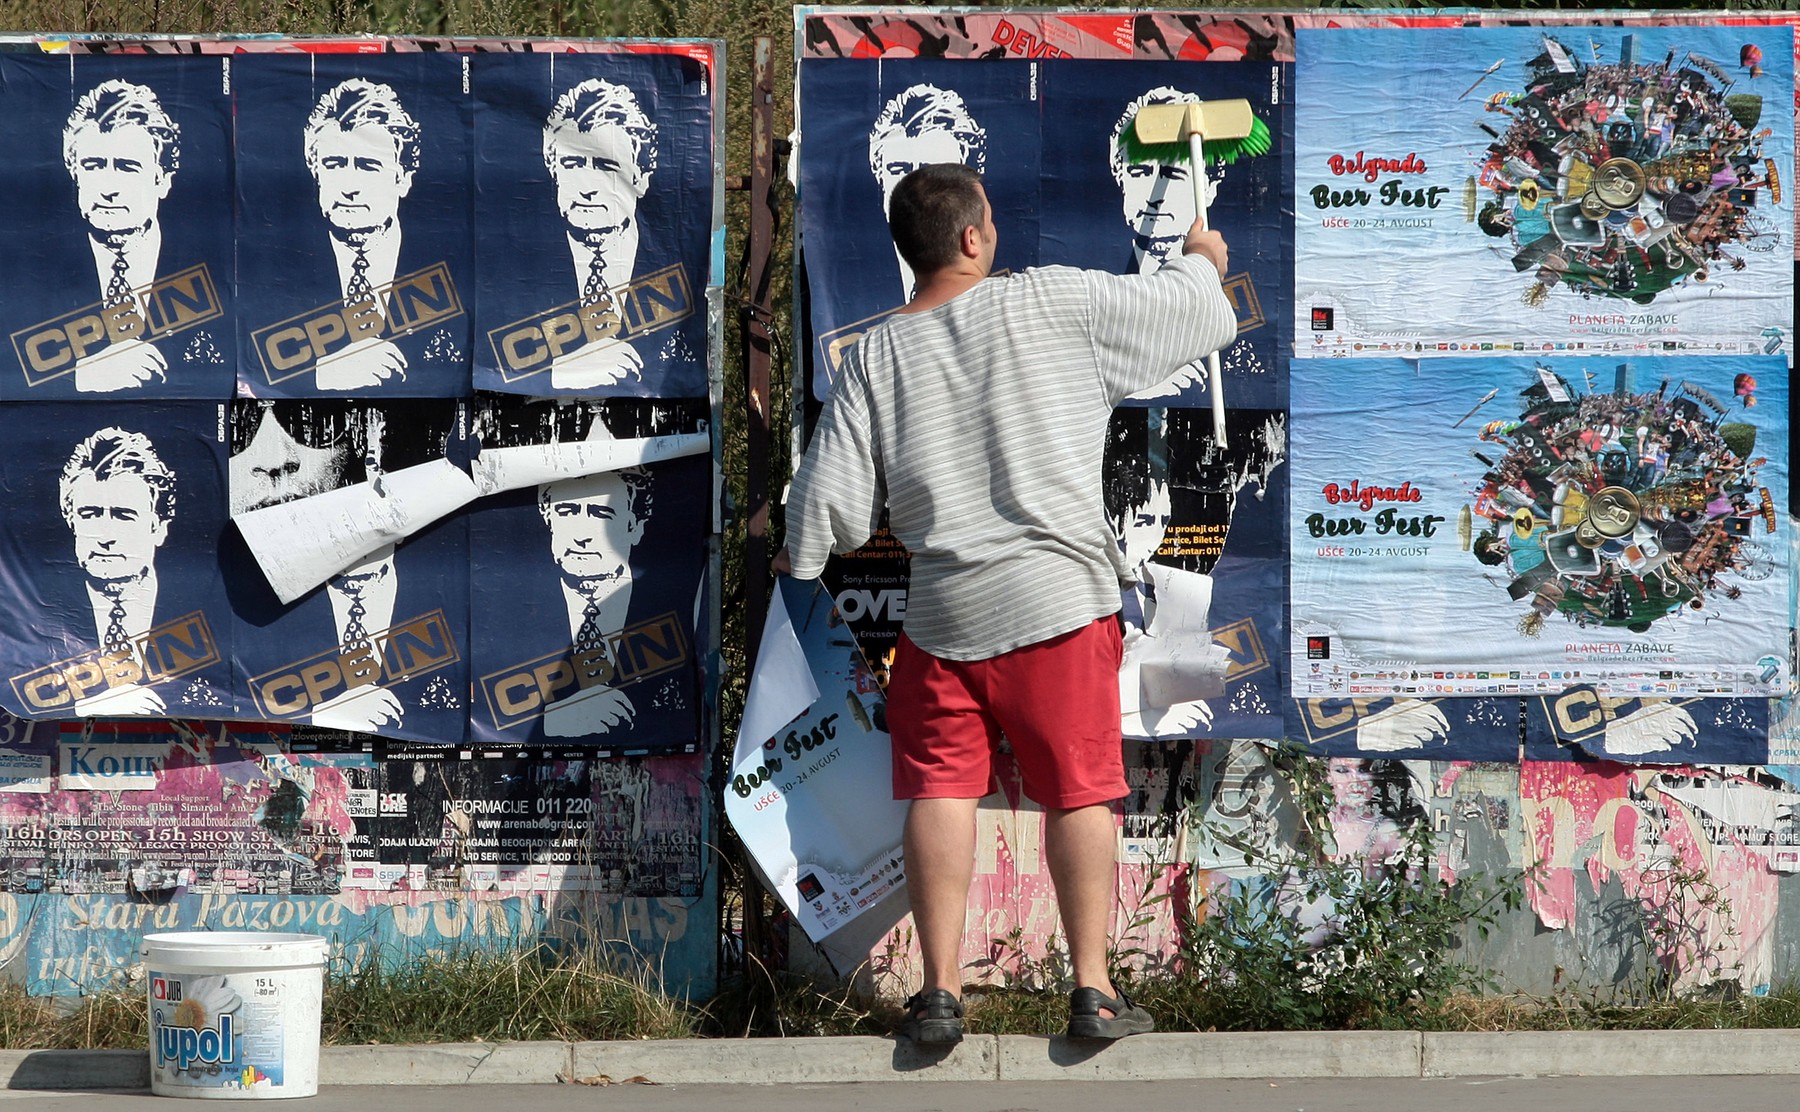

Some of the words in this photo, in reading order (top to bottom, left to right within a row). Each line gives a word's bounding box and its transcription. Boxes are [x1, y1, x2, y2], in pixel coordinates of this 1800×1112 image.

[1327, 150, 1428, 183] Belgrade
[1309, 183, 1372, 210] Beer
[1379, 179, 1450, 210] Fest
[1322, 215, 1350, 228] UŠĆE
[1569, 314, 1625, 325] PLANETA
[1629, 314, 1679, 325] ZABAVE
[1322, 479, 1423, 511] Belgrade
[1304, 512, 1367, 538] Beer
[1374, 508, 1446, 538] Fest
[1175, 524, 1207, 535] prodaji
[1208, 524, 1219, 533] od
[875, 538, 894, 548] Bilet
[1193, 535, 1213, 544] Bilet
[856, 550, 887, 559] Centar:
[1157, 547, 1174, 556] Call
[1317, 545, 1345, 557] UŠĆE
[1385, 547, 1429, 557] AVGUST
[843, 574, 863, 586] Sony
[865, 574, 898, 584] Ericsson
[860, 630, 897, 638] Ericsson
[1565, 643, 1621, 654] PLANETA
[1625, 643, 1675, 654] ZABAVE
[387, 752, 415, 761] medijski
[732, 755, 783, 799] Beer
[783, 712, 839, 761] Fest
[753, 791, 781, 812] UŠĆE
[809, 747, 842, 775] AVGUST
[161, 794, 180, 802] Local
[181, 794, 210, 803] Support
[116, 803, 144, 812] Stone
[442, 799, 529, 814] INFORMACIJE
[536, 798, 561, 814] 011
[565, 798, 592, 814] 220
[82, 812, 97, 826] will
[97, 812, 107, 826] be
[191, 812, 206, 827] and
[6, 824, 46, 840] 16h
[85, 830, 132, 842] OPEN
[147, 825, 187, 842] 15h
[63, 841, 94, 849] INFO
[346, 848, 375, 858] STORE
[481, 852, 520, 862] SERVICE,
[64, 893, 179, 931] Stara
[192, 893, 344, 931] Pazova
[255, 978, 266, 987] 15
[269, 978, 274, 987] L
[166, 980, 182, 1002] JUB
[155, 1008, 234, 1071] jupol
